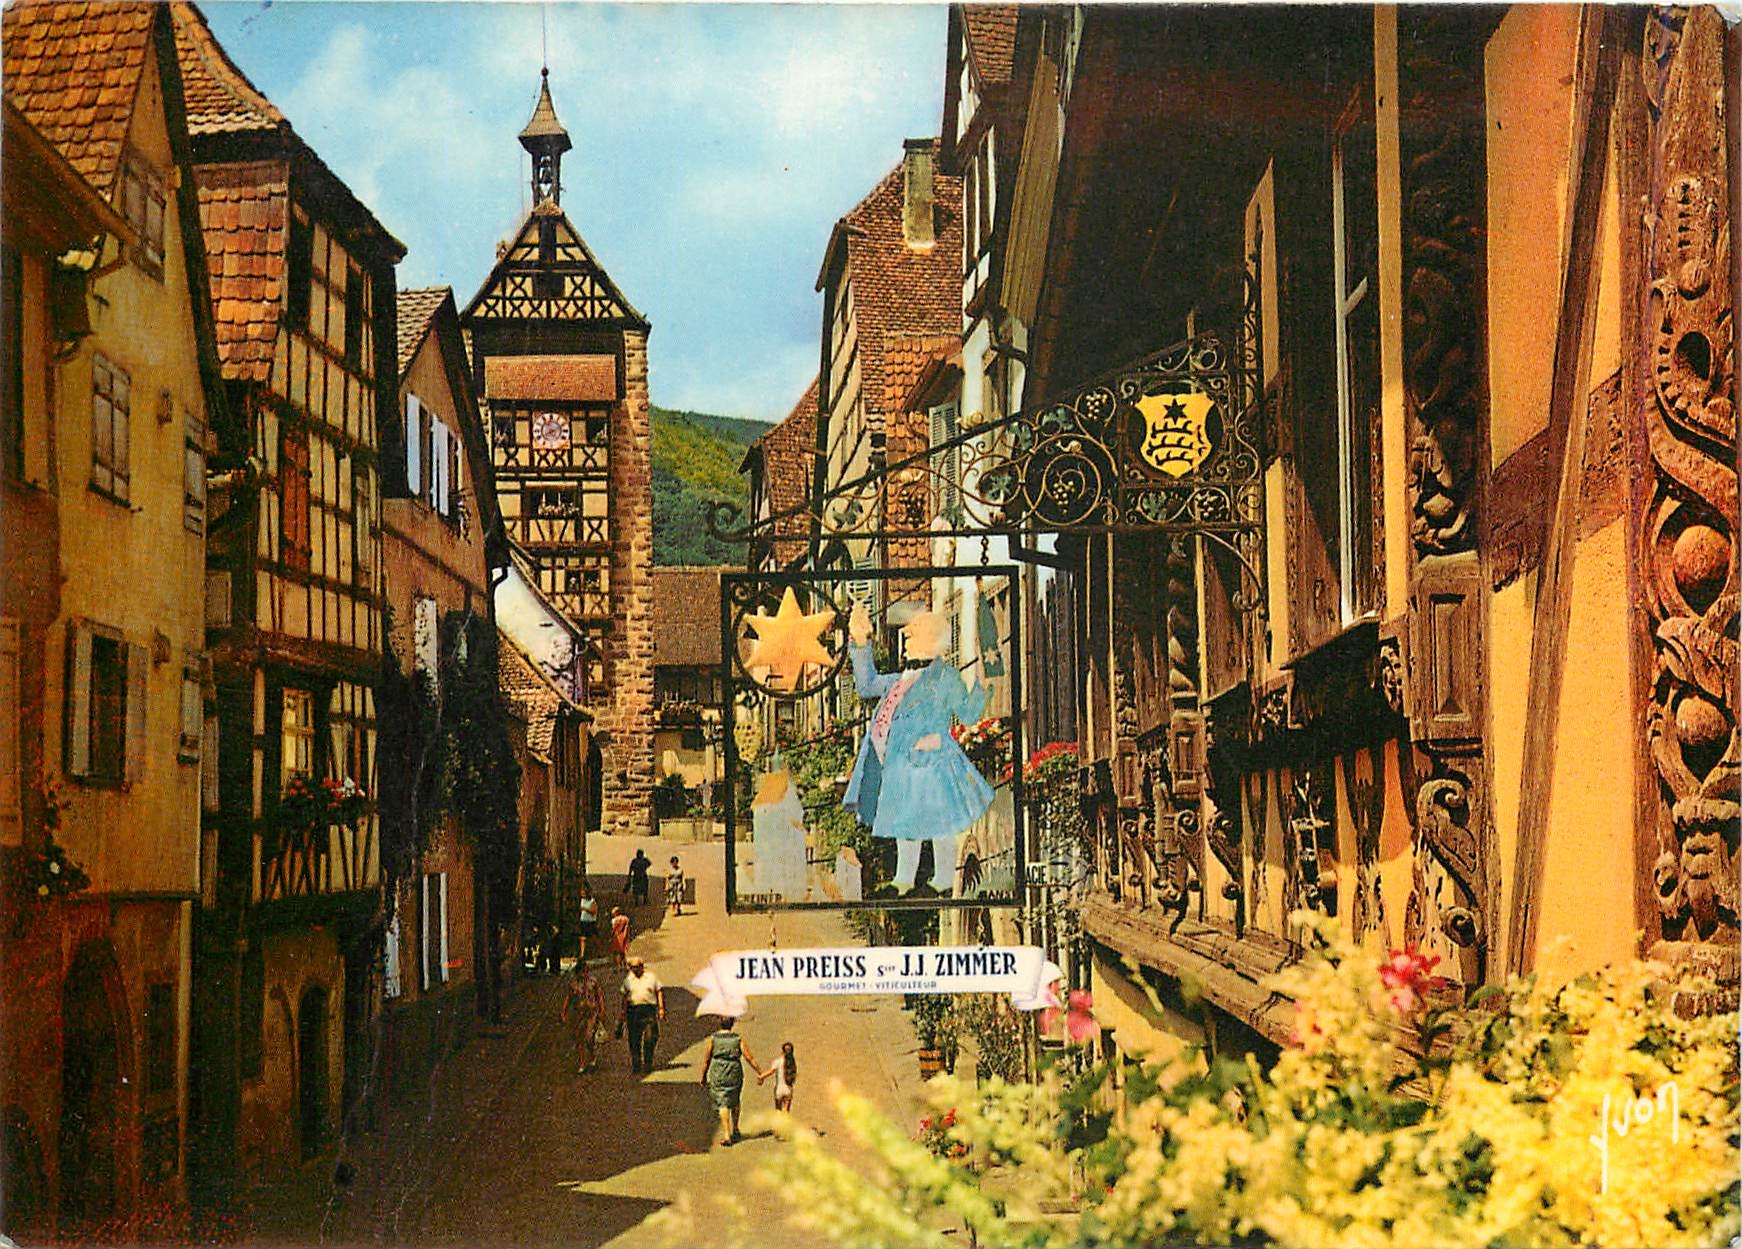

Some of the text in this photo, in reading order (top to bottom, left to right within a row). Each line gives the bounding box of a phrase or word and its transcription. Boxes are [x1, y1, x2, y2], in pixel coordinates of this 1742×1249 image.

[736, 957, 785, 979] JEAN
[793, 955, 867, 978] PREISS
[935, 952, 1017, 976] ZIMMER
[819, 980, 937, 990] GOURMET VITICULTEUR
